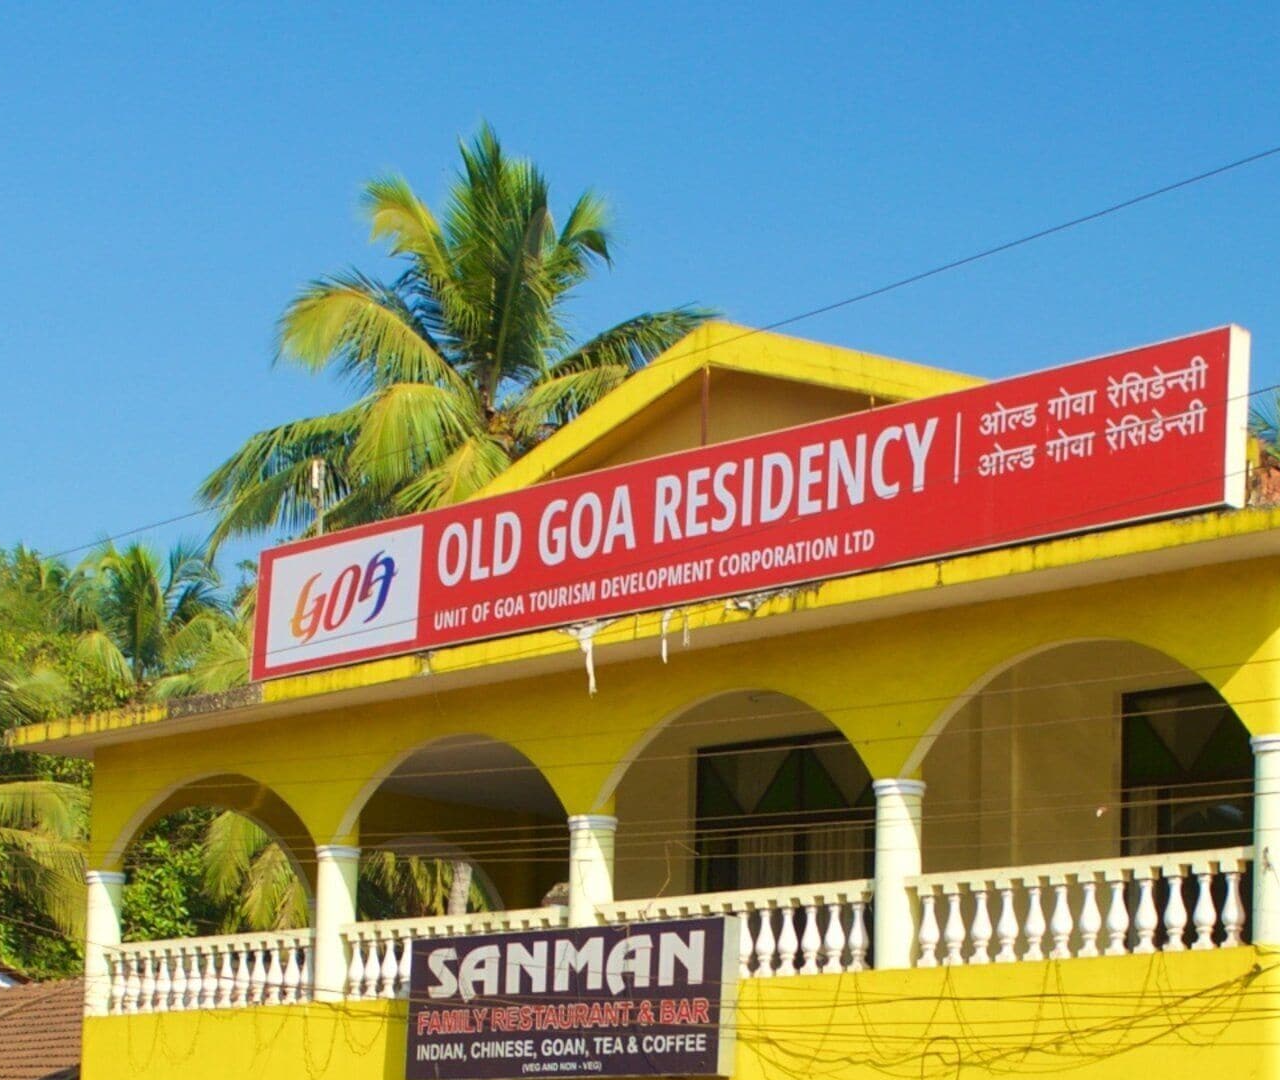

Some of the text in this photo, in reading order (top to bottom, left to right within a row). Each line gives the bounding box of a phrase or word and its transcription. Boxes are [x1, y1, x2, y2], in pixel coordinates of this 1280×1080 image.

[979, 355, 1208, 436] ओल्ड गोवा रेसिडेन्सी
[978, 399, 1207, 477] ओल्ड गोवा रेसिडेन्सी
[436, 416, 939, 588] OLD GOA RESIDENCY
[434, 529, 875, 631] UNIT OF GOA TOURISM DEVELOPMENT CORPORATION LTD
[426, 929, 707, 1003] SANMAN
[416, 1033, 707, 1062] INDIAN, CHINESE, GOAN, TEA & COFFEE
[417, 997, 710, 1036] FAMILY RESTAURANT & BAR
[522, 1062, 541, 1074] (VEG
[541, 1062, 559, 1072] AND
[560, 1061, 577, 1071] NON
[583, 1060, 603, 1072] VEG)
